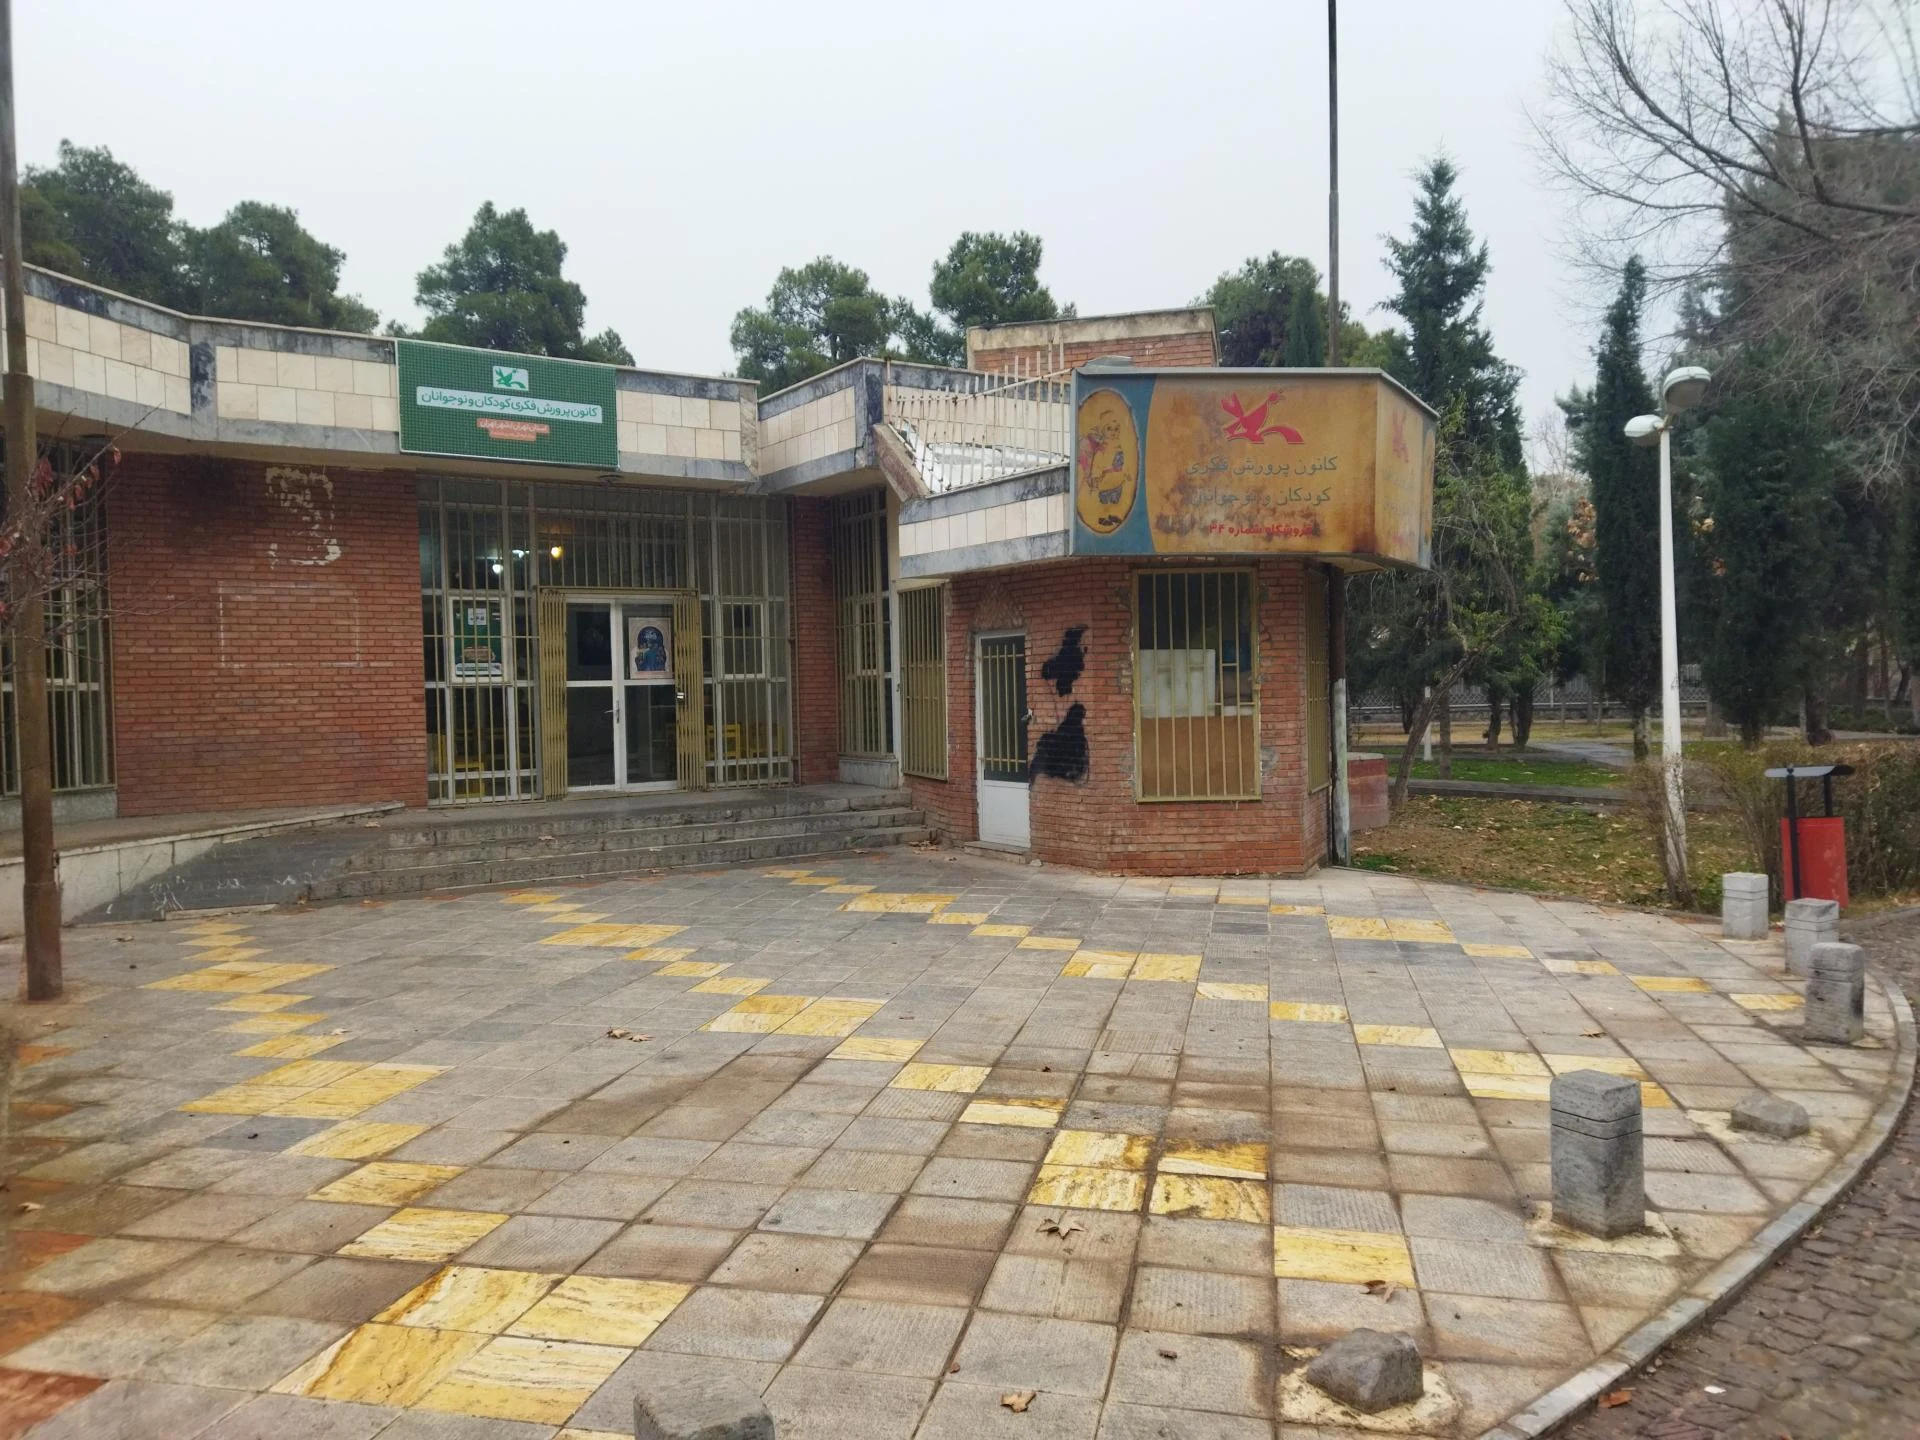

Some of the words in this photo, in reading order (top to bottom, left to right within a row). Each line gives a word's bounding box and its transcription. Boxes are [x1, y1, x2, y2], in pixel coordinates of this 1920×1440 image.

[468, 398, 474, 407] و
[475, 395, 511, 410] کودکان
[511, 400, 537, 412] فکری
[537, 402, 571, 417] پرورش
[571, 406, 598, 418] کانون
[1185, 455, 1229, 476] فکری
[1233, 456, 1290, 476] پرورش
[1294, 456, 1338, 476] کانون
[1262, 496, 1272, 506] و
[1277, 487, 1332, 506] کودکان
[1228, 522, 1263, 537] شماره
[1265, 522, 1314, 537] فروشگاه
